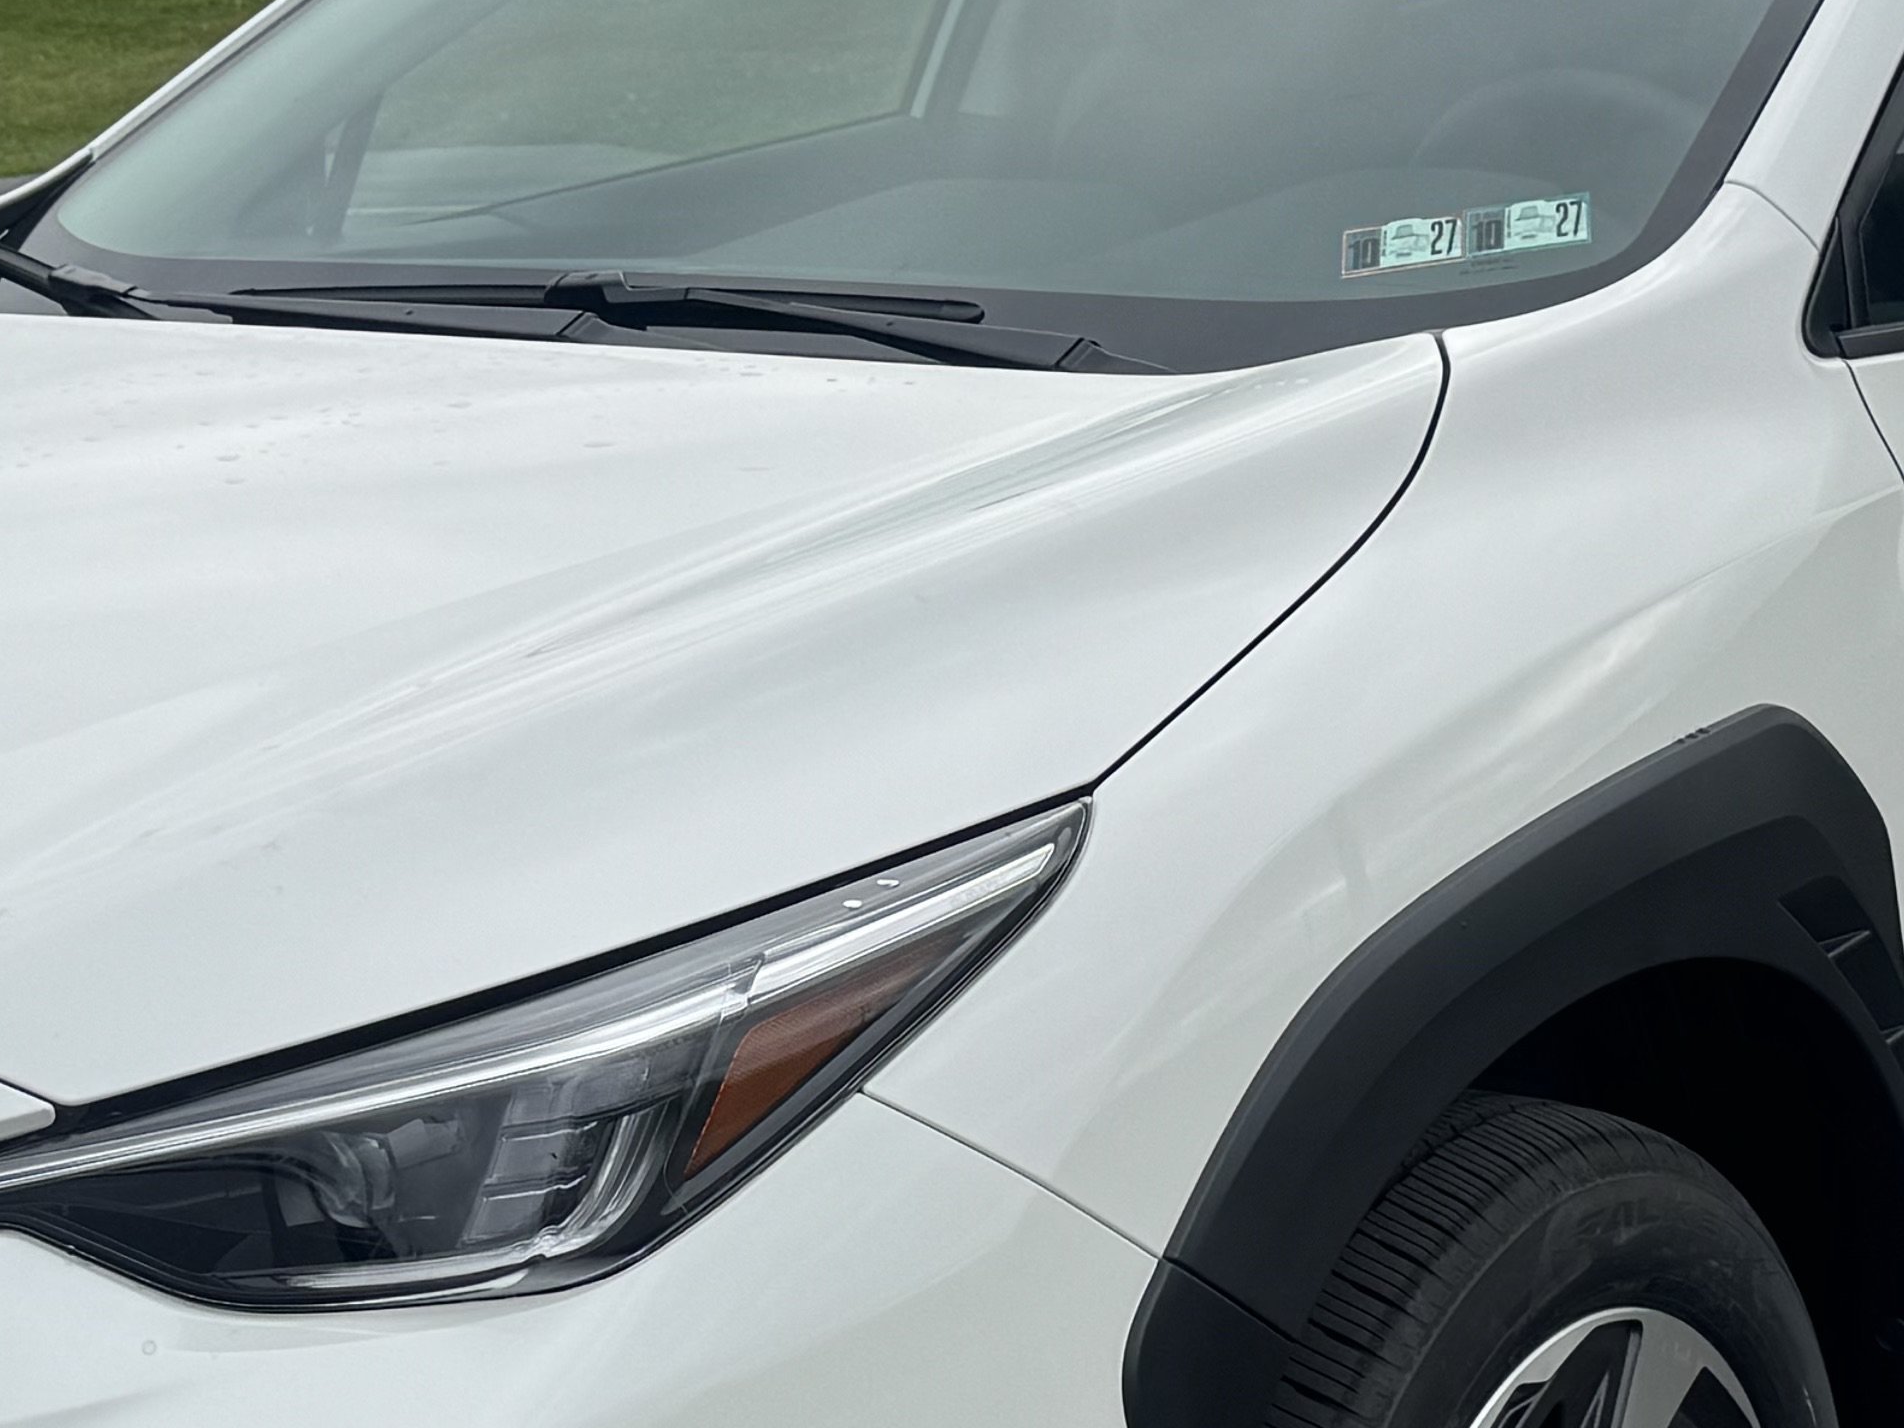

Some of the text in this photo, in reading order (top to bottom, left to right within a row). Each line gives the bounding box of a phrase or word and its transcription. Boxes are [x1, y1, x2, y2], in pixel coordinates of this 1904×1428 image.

[1348, 237, 1380, 269] 10
[1430, 219, 1457, 256] 27
[1471, 219, 1504, 252] 10
[1556, 199, 1582, 238] 27
